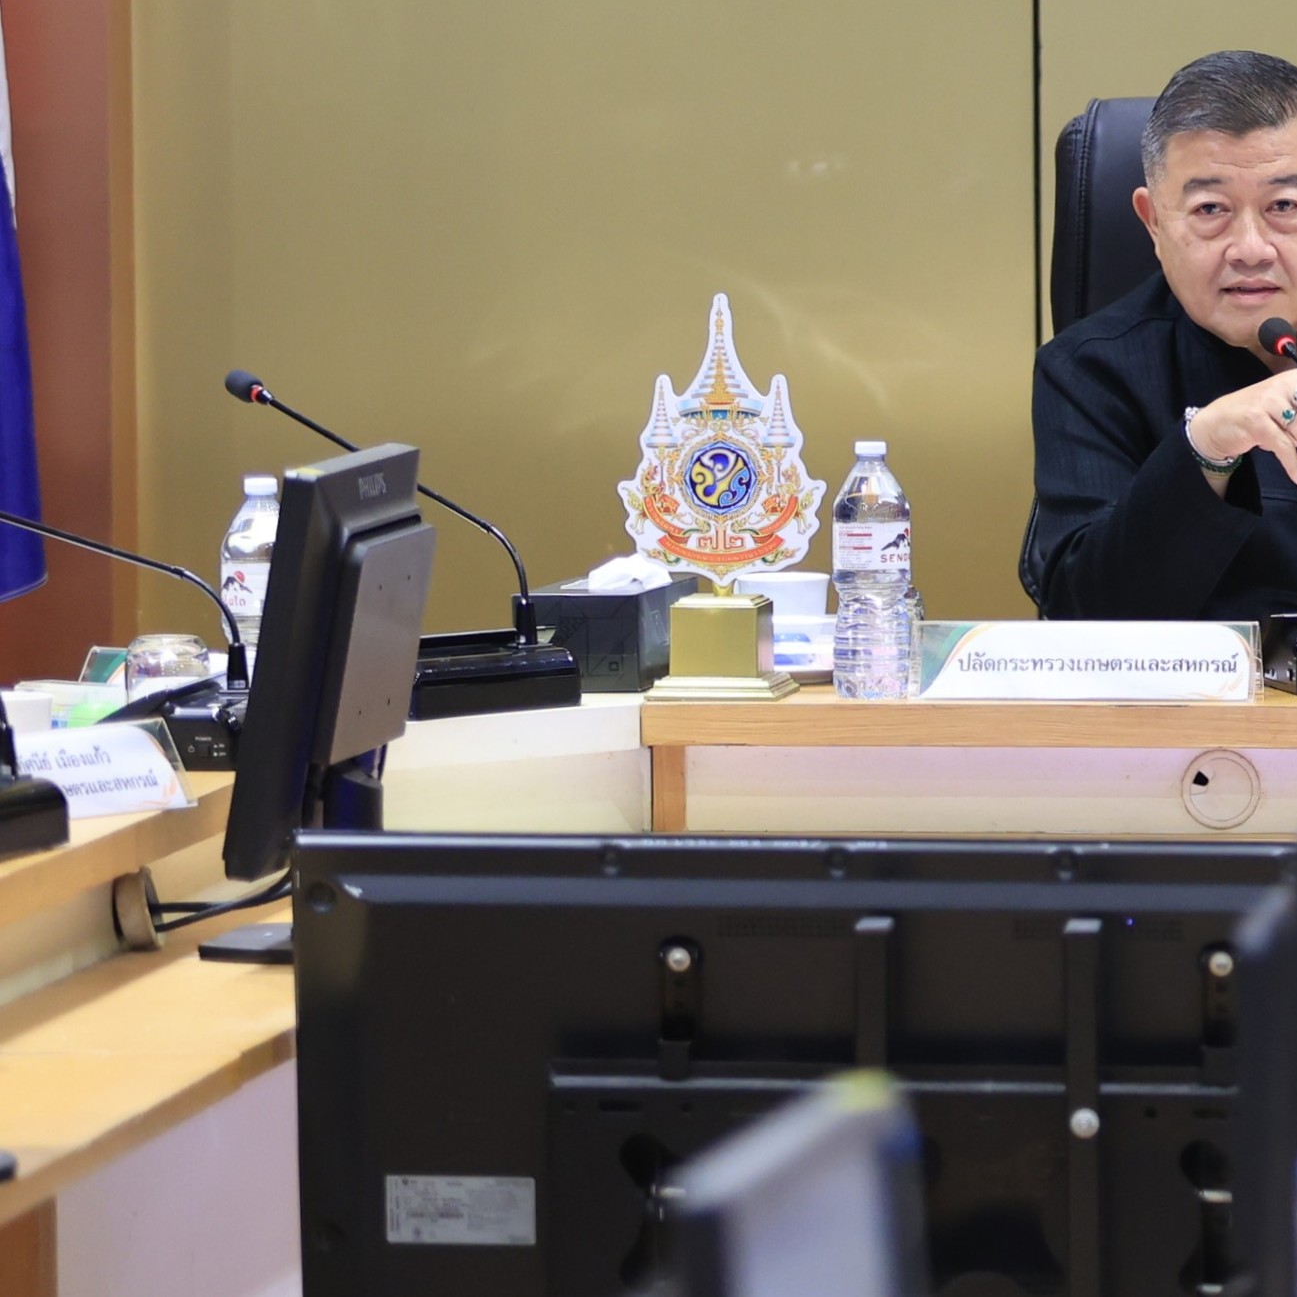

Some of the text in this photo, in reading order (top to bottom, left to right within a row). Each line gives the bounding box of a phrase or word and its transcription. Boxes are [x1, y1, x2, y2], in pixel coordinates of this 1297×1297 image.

[957, 652, 1239, 674] ปลัดกระทรวงเกษตรและสหกรณ์
